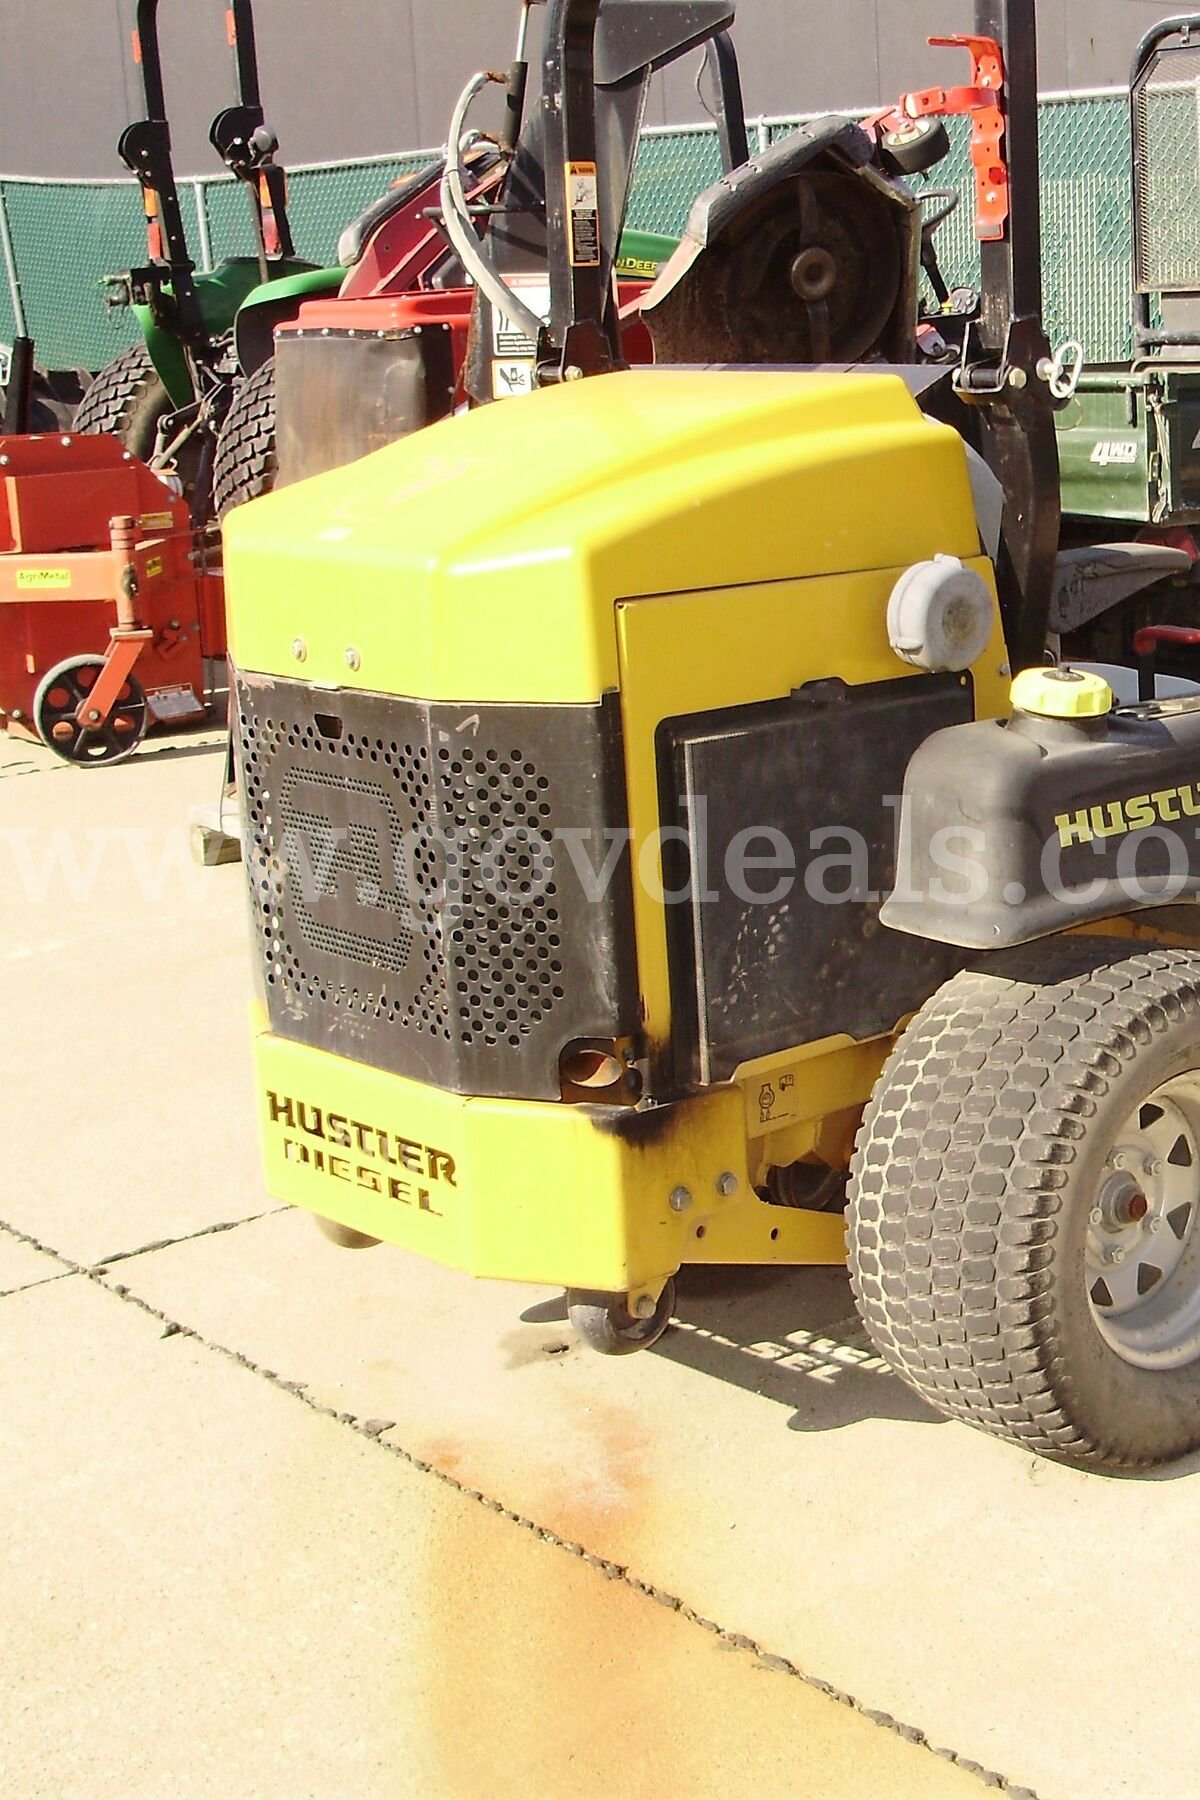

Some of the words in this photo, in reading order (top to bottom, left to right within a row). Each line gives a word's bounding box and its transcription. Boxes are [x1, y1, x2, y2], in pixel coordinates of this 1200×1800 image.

[626, 257, 658, 270] DEER
[1090, 441, 1138, 466] 4WD
[266, 1089, 458, 1188] HUSTLER
[283, 1137, 444, 1217] DIESEL
